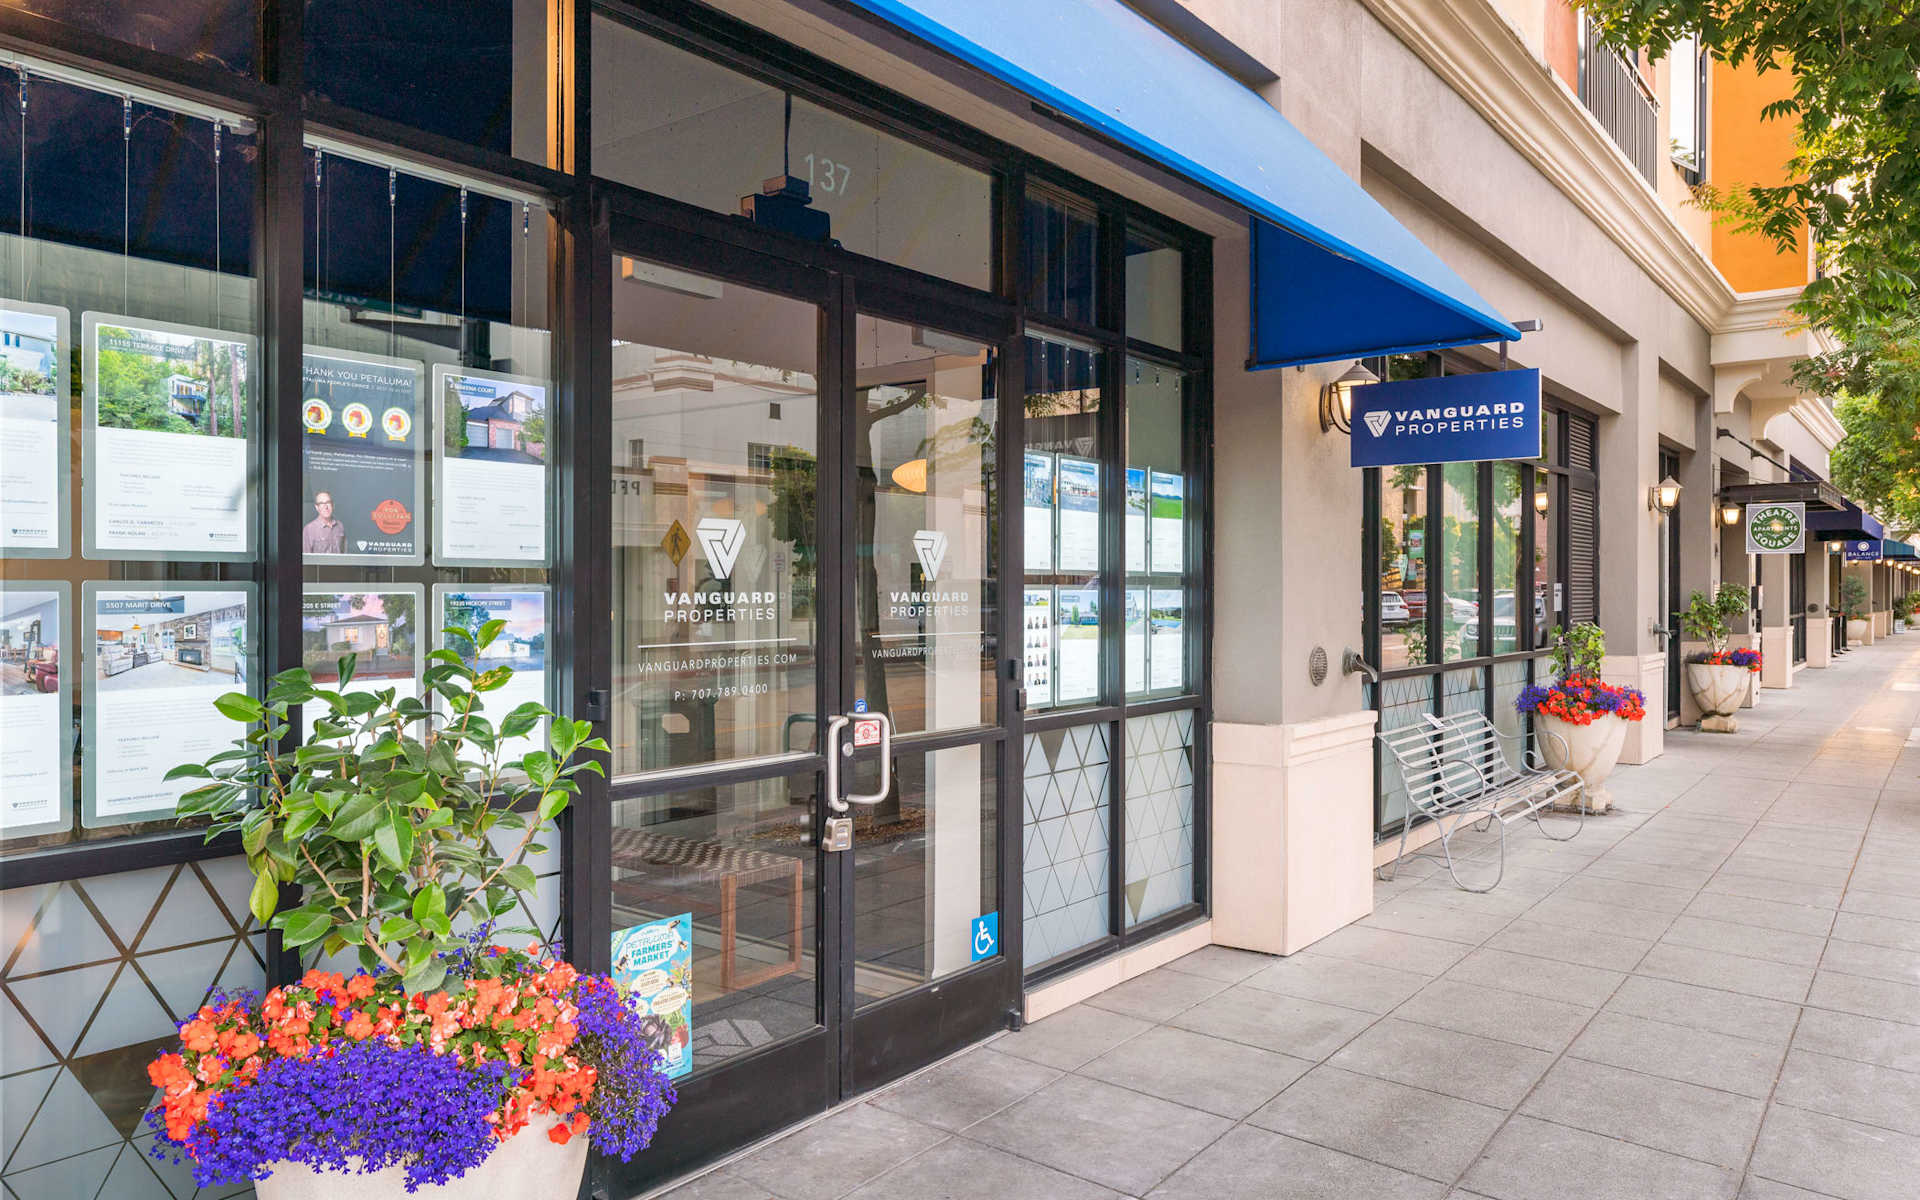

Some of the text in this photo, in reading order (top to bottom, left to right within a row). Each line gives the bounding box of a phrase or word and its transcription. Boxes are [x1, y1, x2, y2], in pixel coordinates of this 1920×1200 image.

[804, 153, 850, 196] 137
[337, 371, 358, 381] YOU
[360, 374, 413, 387] PETALUMA!
[1394, 402, 1525, 422] VANGUARD
[1395, 417, 1525, 437] PROPERTIES
[1752, 508, 1798, 525] THEATRE
[1754, 532, 1797, 547] SQUARE
[150, 601, 172, 609] DRIVE
[663, 591, 776, 606] VANGUARD
[889, 591, 969, 604] VANGUARD
[664, 608, 776, 623] PROPERTIES
[890, 605, 969, 617] PROPERTIES
[638, 653, 798, 673] VANGUARDPROPERTIES.COM
[674, 683, 769, 702] P: 707.789.0400
[631, 940, 673, 959] FARMERS
[633, 952, 670, 967] MARKET
